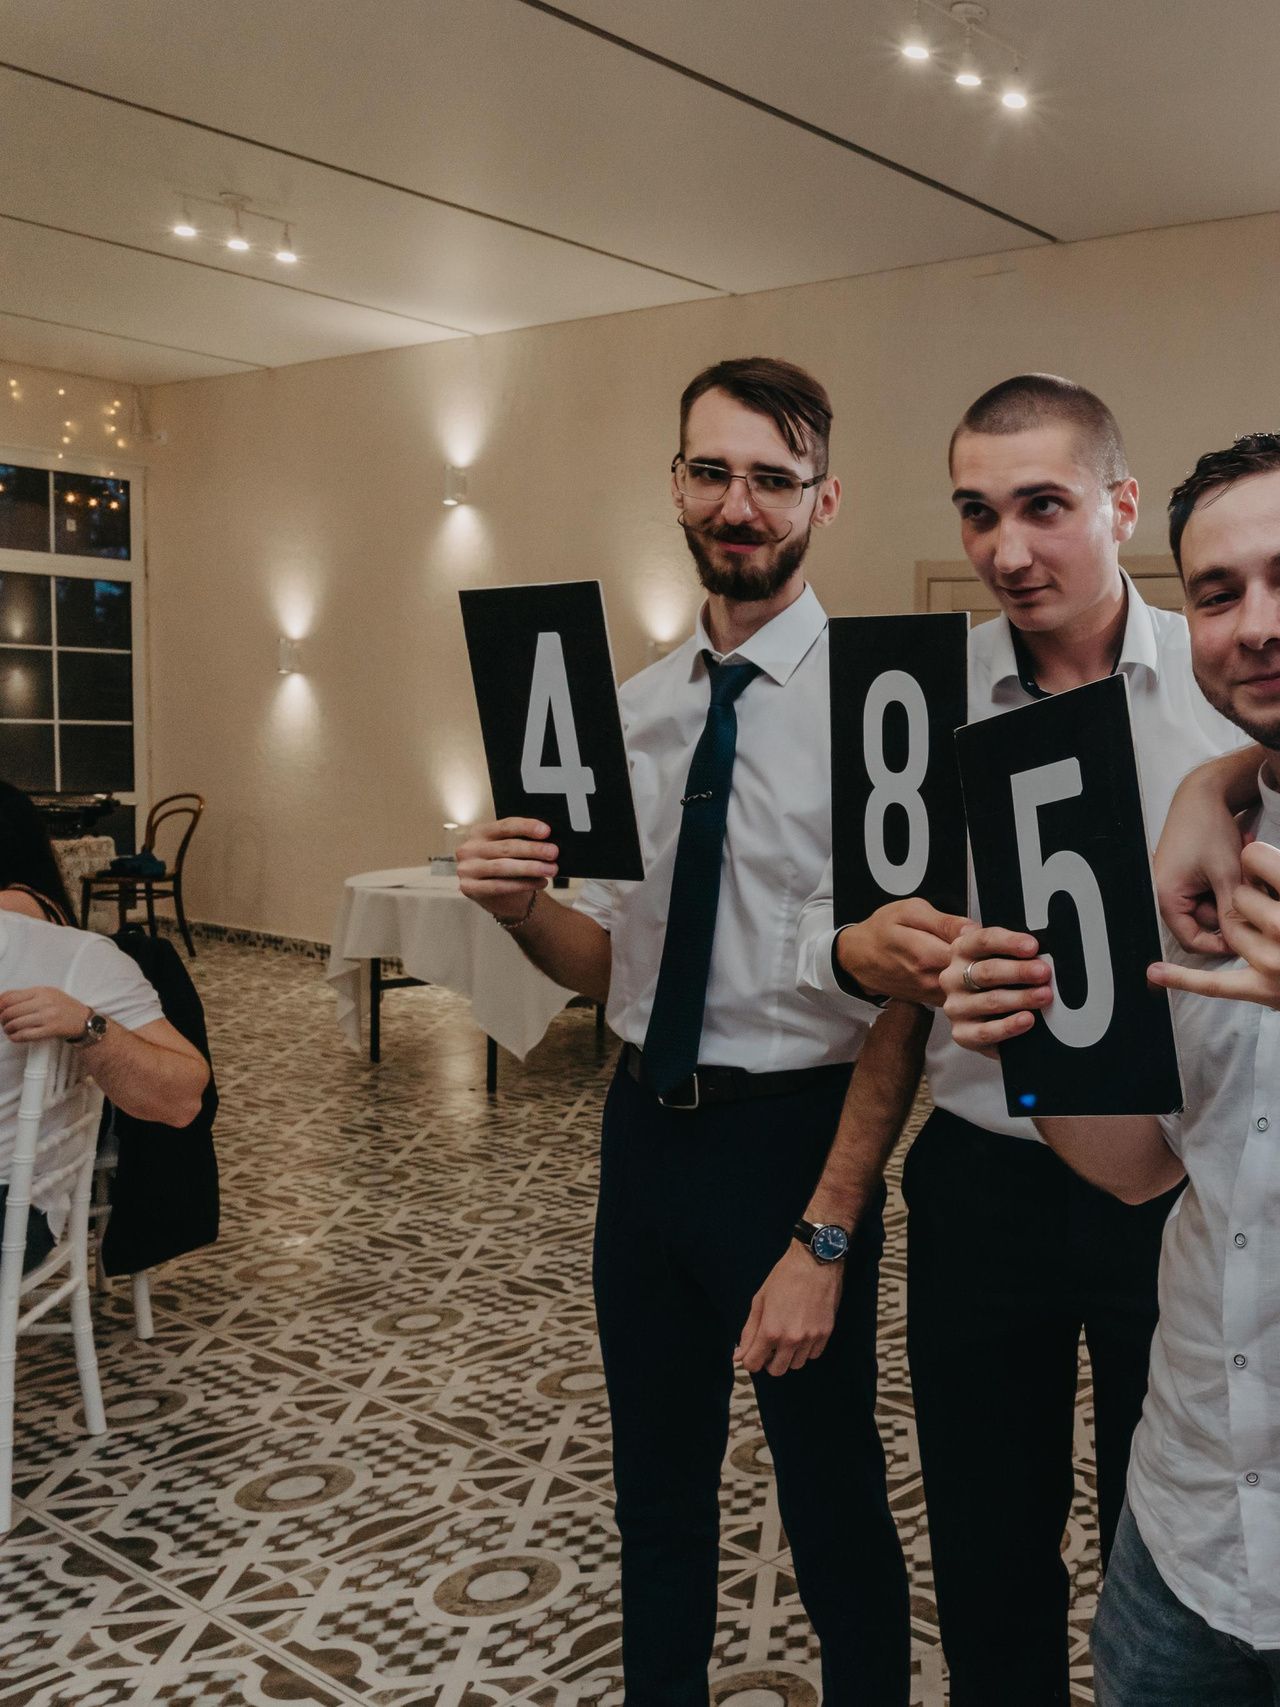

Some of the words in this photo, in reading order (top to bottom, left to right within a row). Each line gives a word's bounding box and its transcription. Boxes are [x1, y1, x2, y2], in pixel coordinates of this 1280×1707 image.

[520, 631, 597, 833] 4
[863, 669, 930, 896] 8
[1010, 756, 1115, 1049] 5
